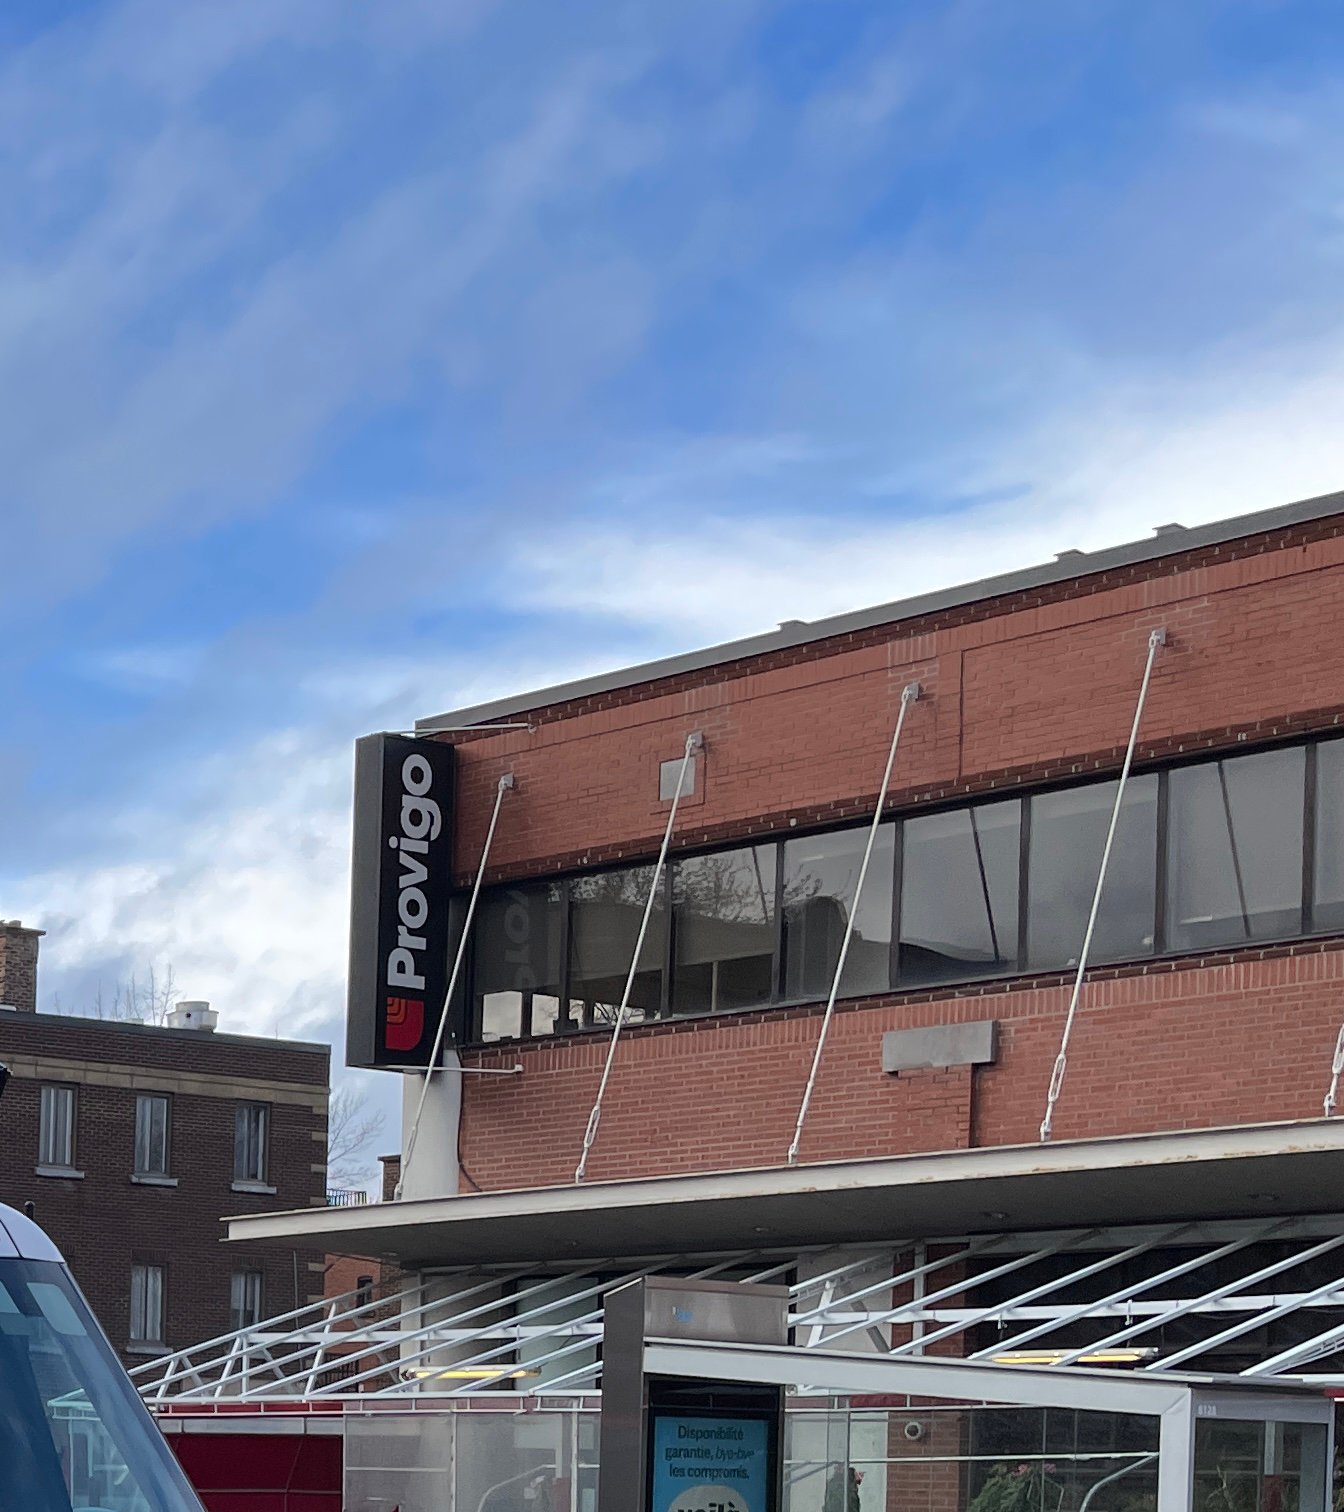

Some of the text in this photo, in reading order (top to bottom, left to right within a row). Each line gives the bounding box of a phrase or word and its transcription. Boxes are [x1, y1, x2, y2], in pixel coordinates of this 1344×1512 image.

[387, 754, 442, 990] Provigo
[677, 1425, 744, 1442] Disponibilité
[665, 1447, 714, 1461] garantie,
[669, 1464, 750, 1481] les compromis.
